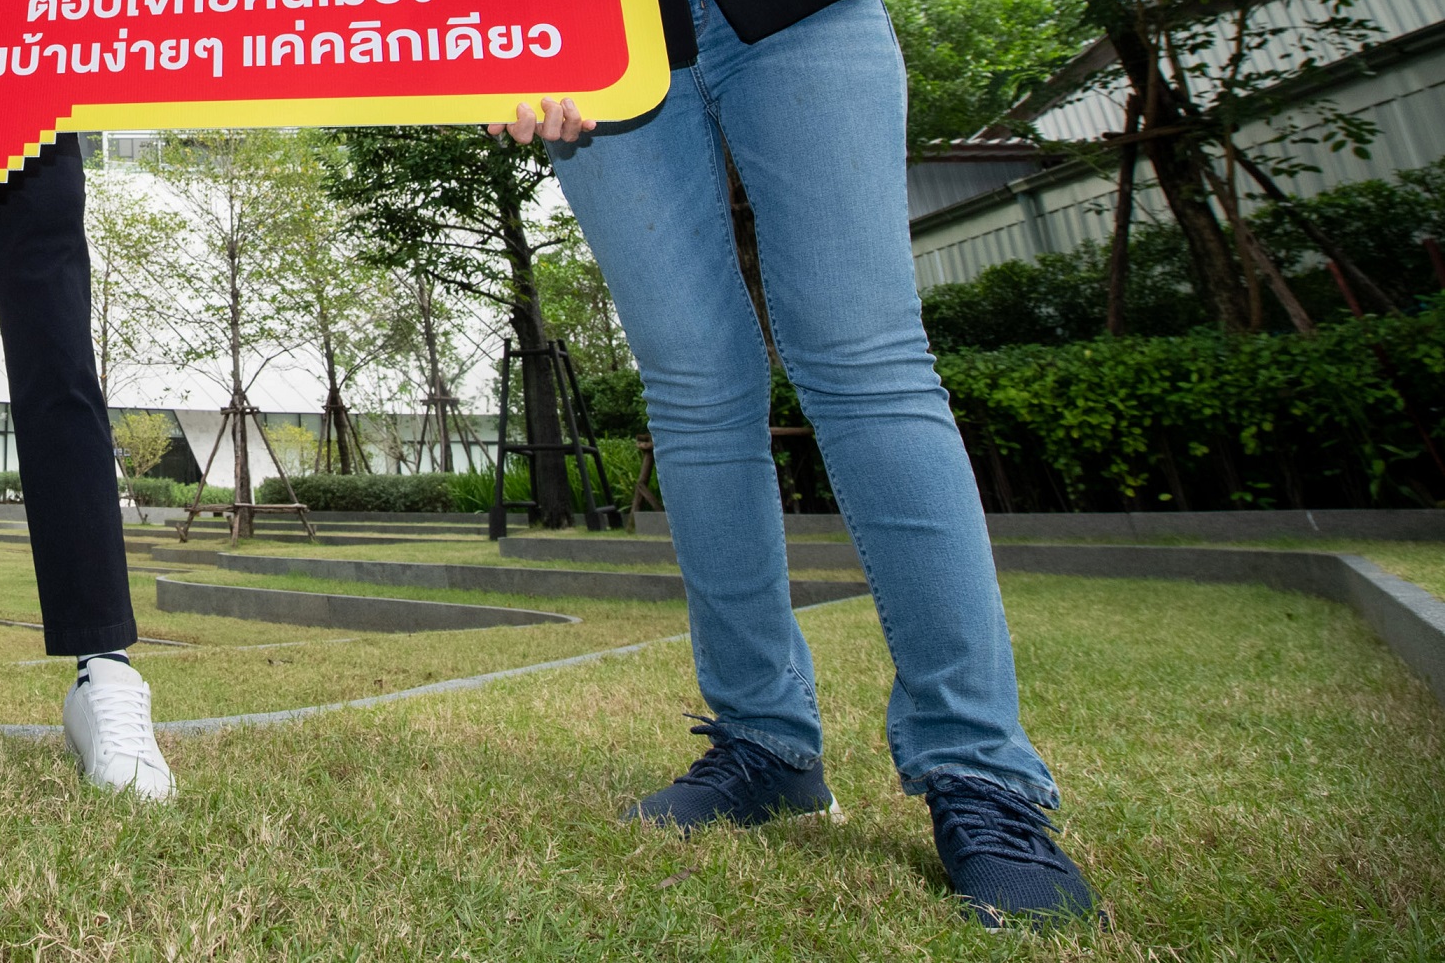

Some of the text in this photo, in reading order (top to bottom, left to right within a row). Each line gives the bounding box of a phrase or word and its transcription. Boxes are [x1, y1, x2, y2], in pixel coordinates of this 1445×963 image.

[243, 12, 562, 67] แค่คลิกเดียว
